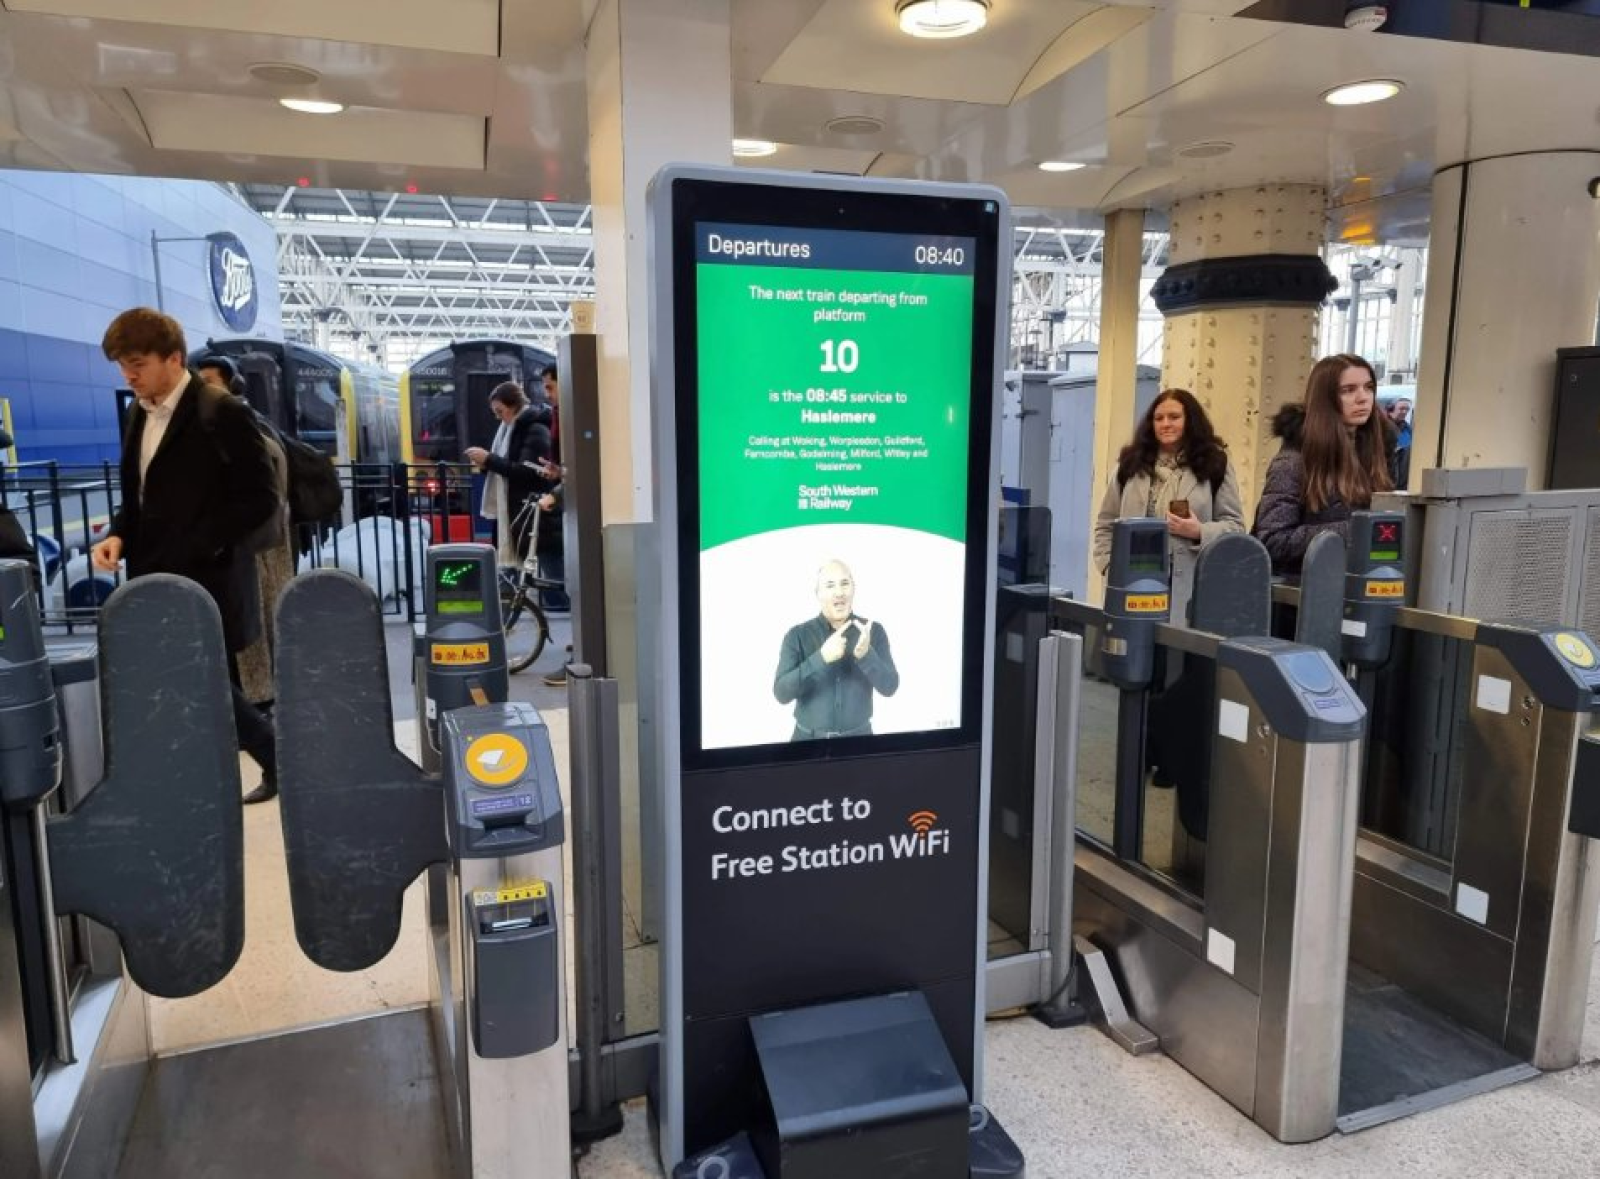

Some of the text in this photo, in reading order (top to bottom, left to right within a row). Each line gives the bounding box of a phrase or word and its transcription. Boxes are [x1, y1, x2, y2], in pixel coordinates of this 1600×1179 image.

[708, 234, 811, 259] Departures
[915, 246, 965, 265] 08:40
[749, 285, 927, 307] The next train departing from
[814, 308, 866, 323] platform
[819, 339, 859, 373] 10
[769, 389, 907, 403] is the 08:45 service to
[801, 410, 876, 424] Haslemere
[748, 435, 780, 447] Calling
[781, 436, 790, 446] at
[792, 435, 826, 447] Woking,
[913, 449, 928, 458] and
[798, 484, 878, 497] South Western
[810, 497, 852, 510] Railway
[712, 797, 871, 833] Connect to
[711, 829, 950, 880] Free Station WiFi
